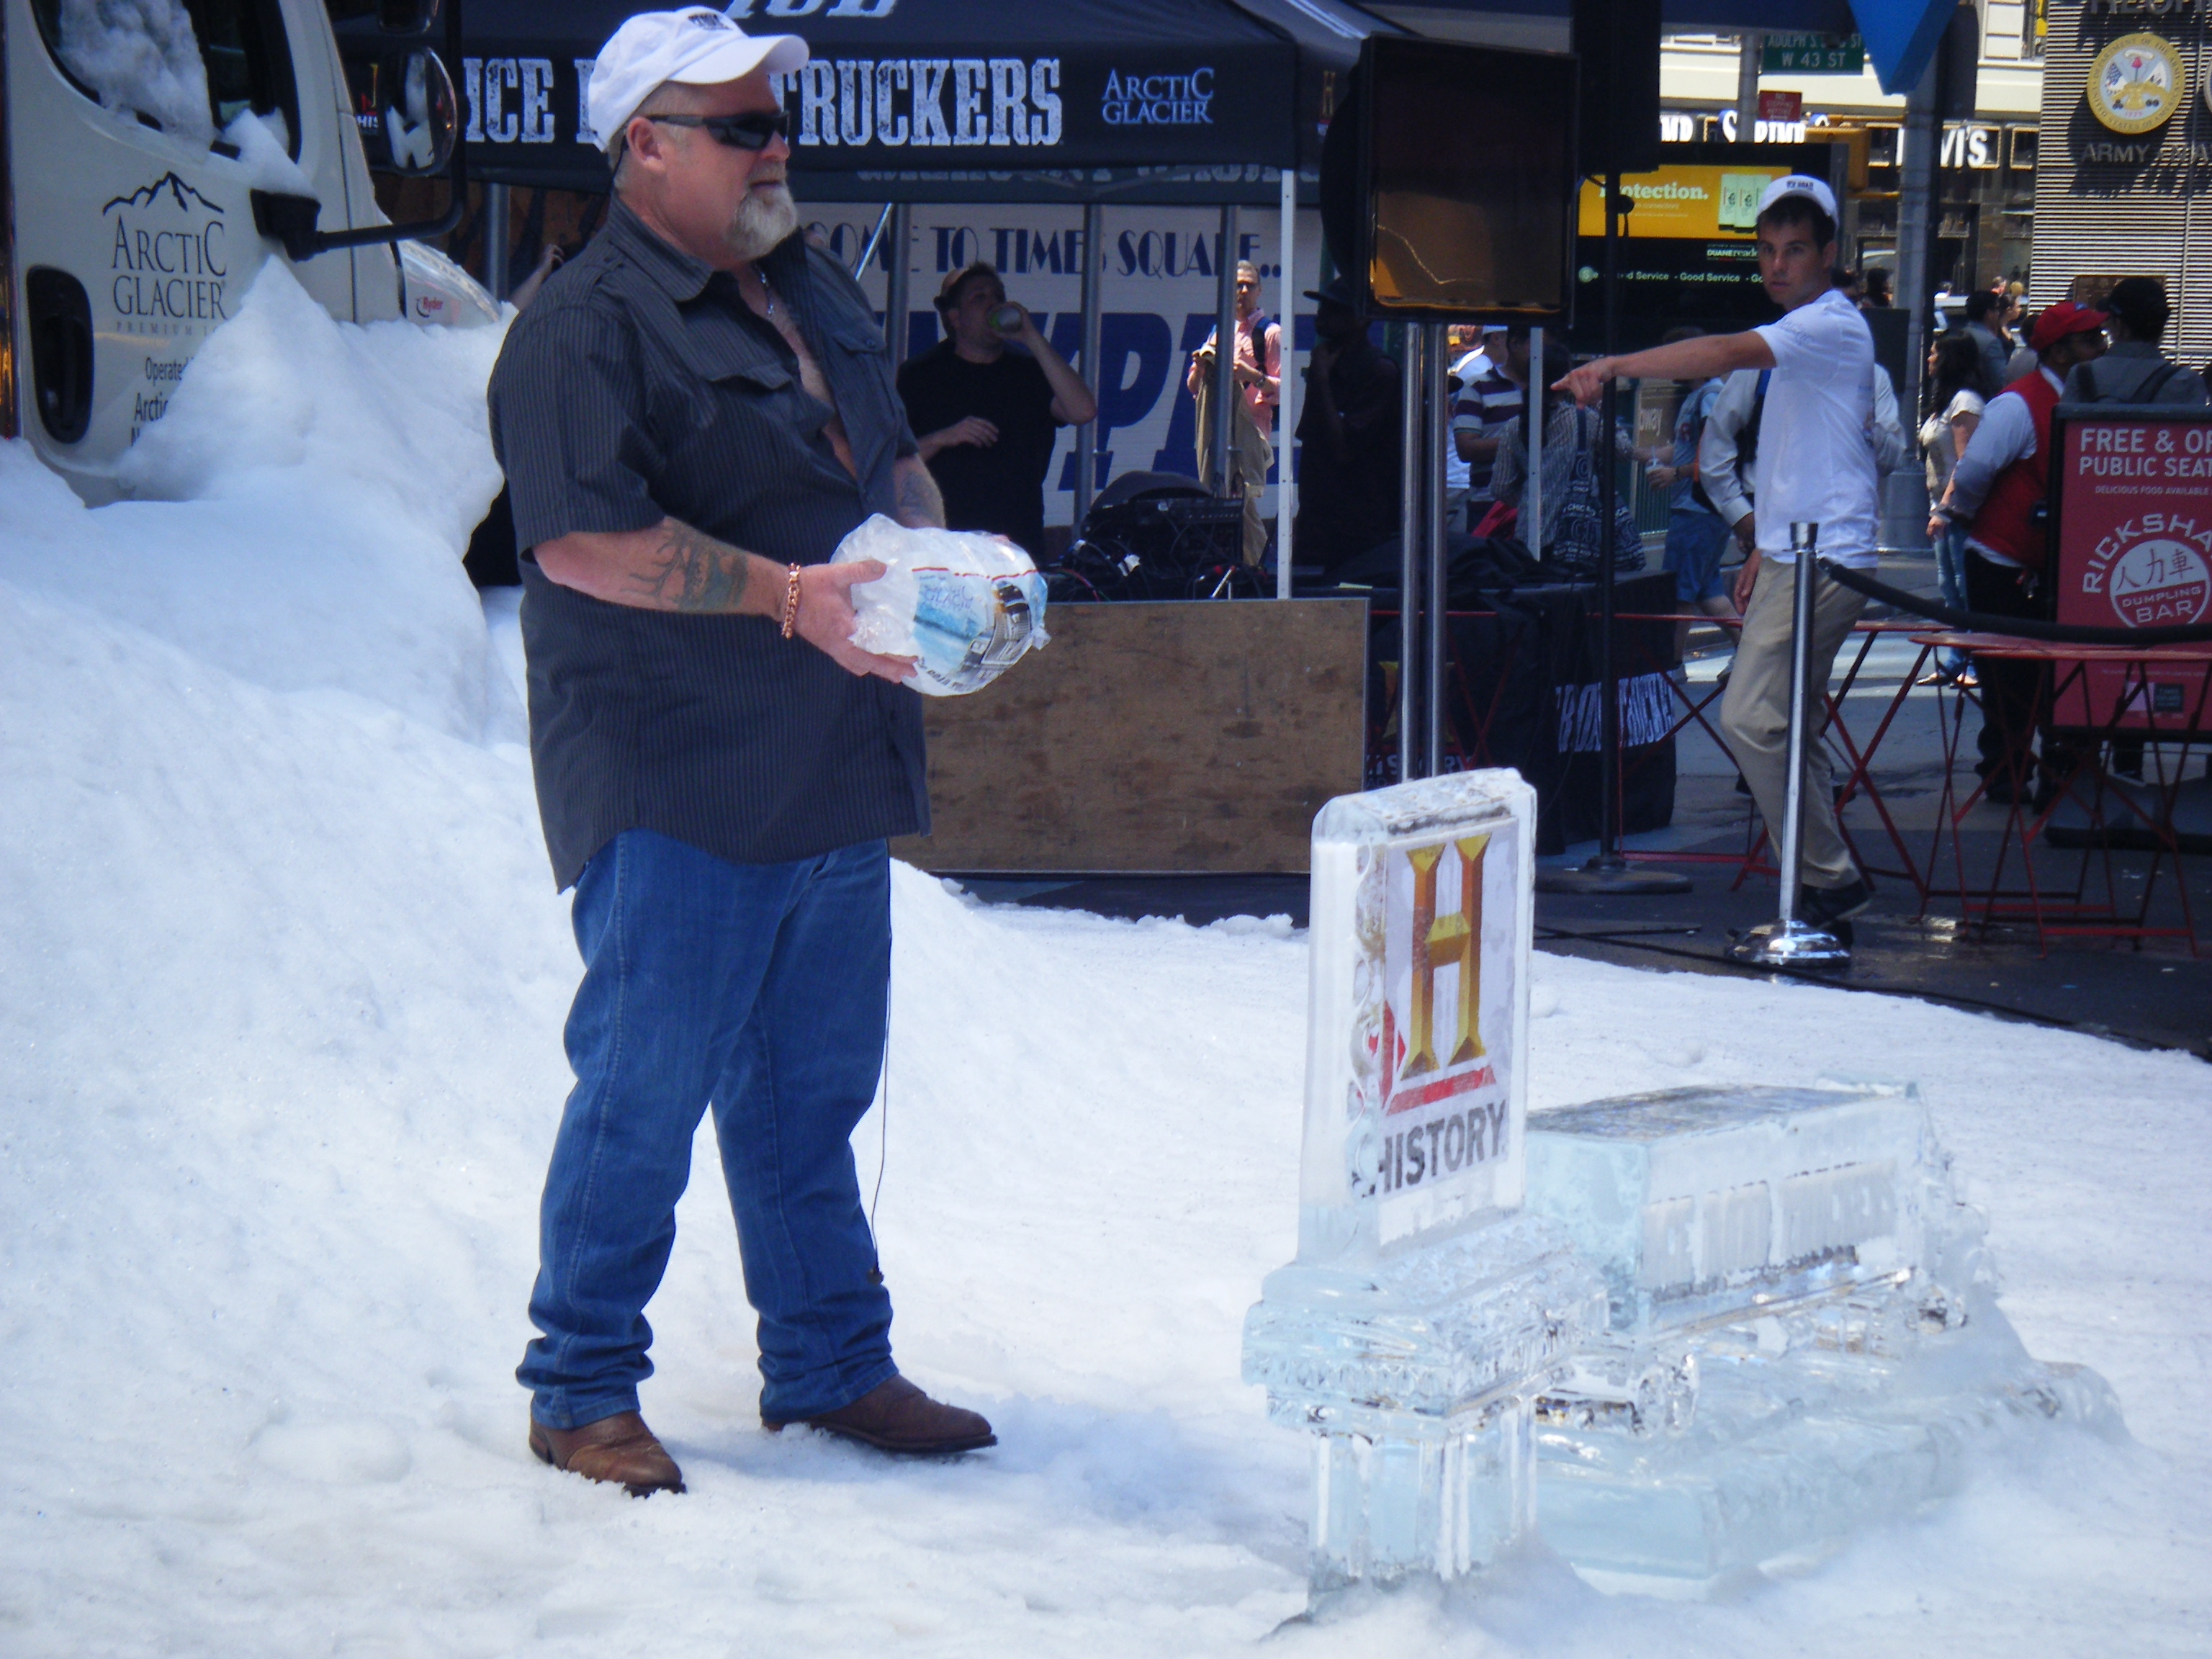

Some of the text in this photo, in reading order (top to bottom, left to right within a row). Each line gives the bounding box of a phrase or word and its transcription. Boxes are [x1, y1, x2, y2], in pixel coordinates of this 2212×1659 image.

[1782, 52, 1845, 68] W 43 ST
[464, 58, 555, 143] ICE
[1102, 99, 1215, 125] GLACIER
[2082, 143, 2152, 163] ARMY
[929, 226, 979, 273] TO
[989, 228, 1107, 274] TIME
[1636, 271, 1670, 281] Service
[1680, 272, 1704, 282] Good
[1707, 273, 1741, 282] Service
[113, 274, 228, 320] GLACIER
[116, 321, 192, 336] PREMIUM
[2080, 428, 2146, 454] FREE
[2154, 429, 2175, 454] &
[2079, 457, 2157, 477] PUBLIC
[2095, 485, 2209, 496] DELICIOUS FOOD AVAILABLE
[2116, 548, 2194, 592] 人力車
[2122, 586, 2202, 608] DUMPLING
[2136, 600, 2193, 624] BAR
[1370, 1099, 1506, 1195] HISTORY
